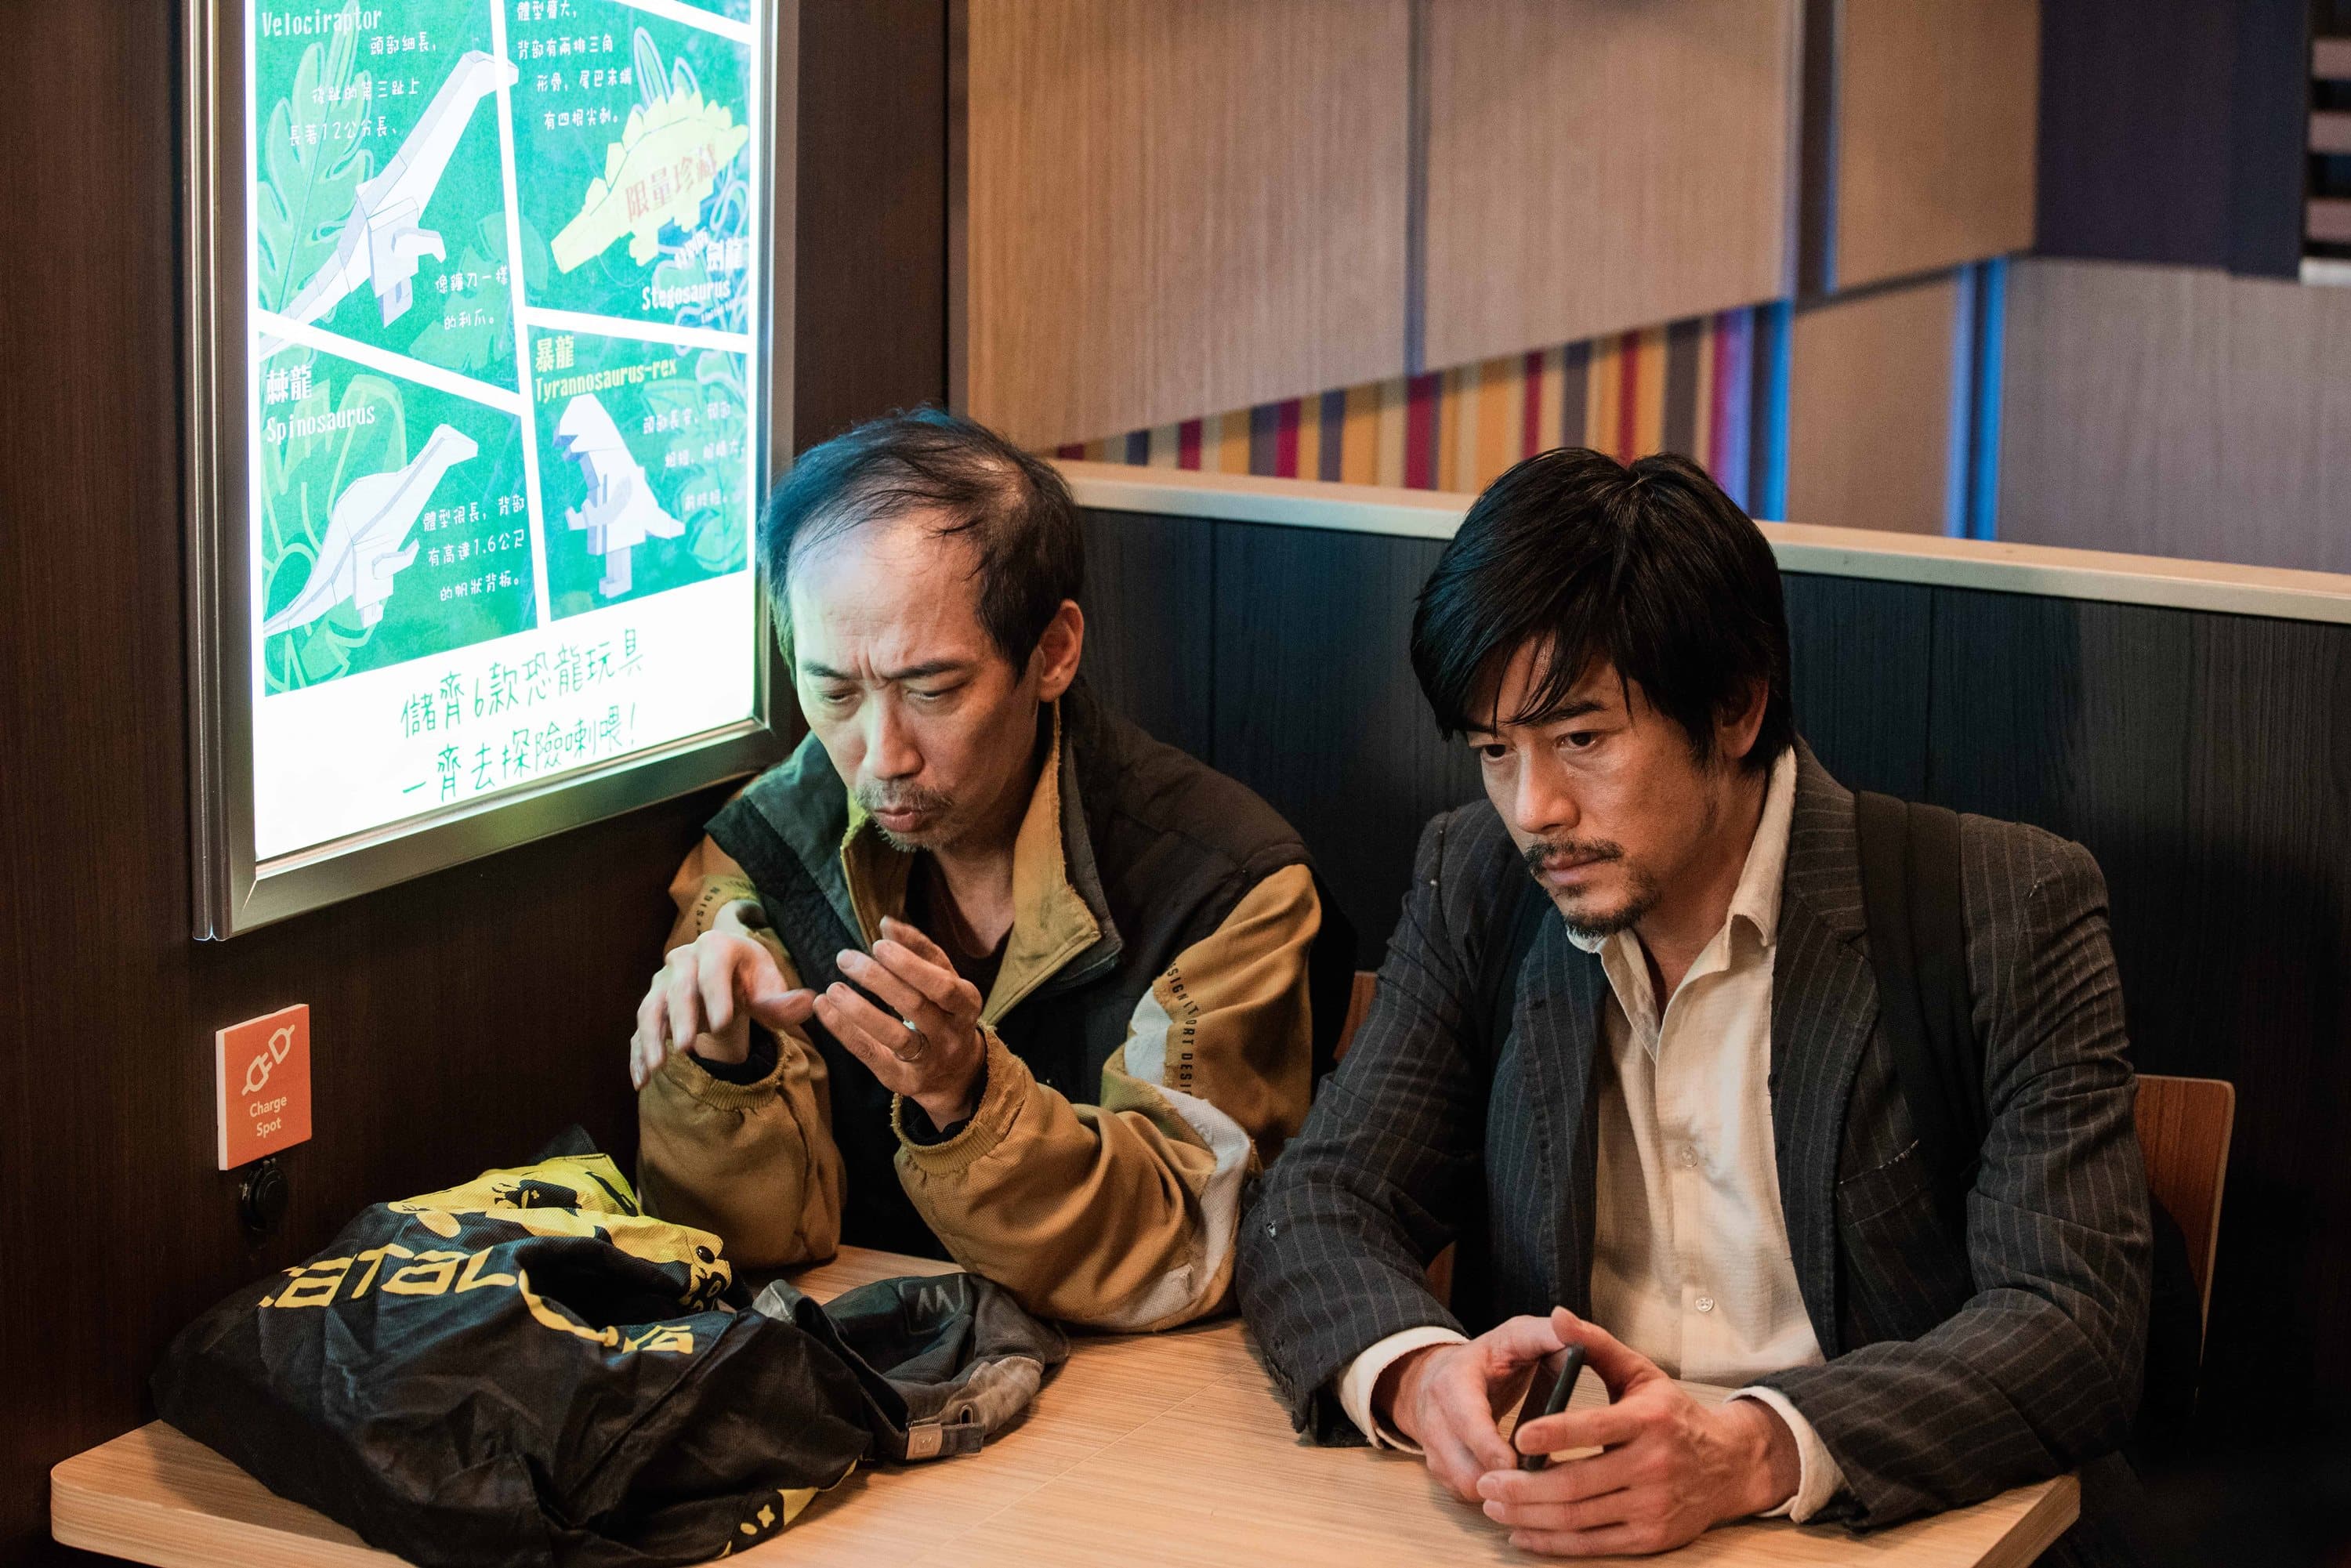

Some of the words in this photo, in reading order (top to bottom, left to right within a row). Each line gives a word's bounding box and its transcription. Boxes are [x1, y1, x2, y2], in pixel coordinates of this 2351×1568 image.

[262, 6, 382, 38] Velociraptor
[642, 279, 731, 312] Stegosaurus
[534, 335, 575, 373] 暴龍
[266, 364, 313, 406] 棘龍
[534, 358, 678, 405] Tyrannosaurus-rex
[266, 405, 376, 444] Spinosaurus
[400, 628, 643, 739] 儲齊6款恐龍玩具
[249, 1096, 288, 1117] Charge
[256, 1117, 282, 1139] Spot
